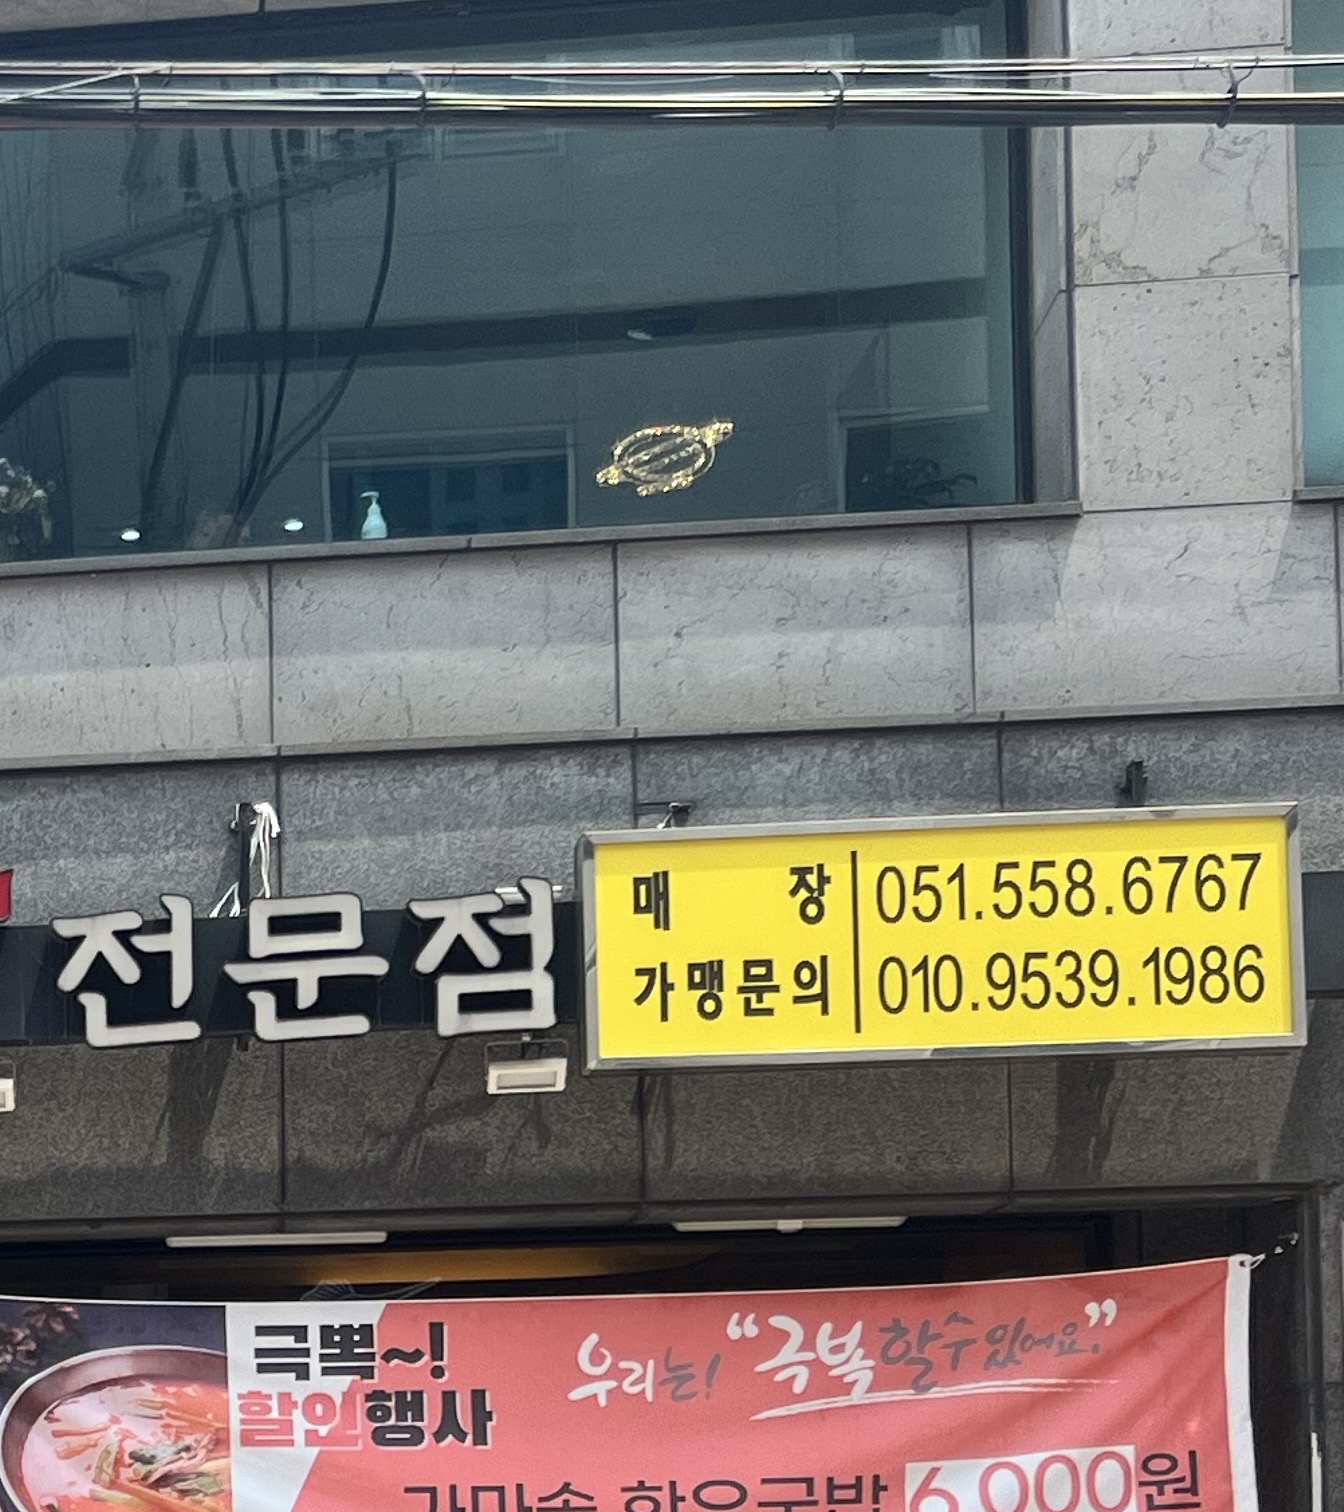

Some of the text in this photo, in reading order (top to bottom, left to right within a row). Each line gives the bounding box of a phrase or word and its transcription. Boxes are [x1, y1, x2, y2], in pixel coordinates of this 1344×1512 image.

[874, 852, 1262, 928] 051.558.6767
[54, 876, 561, 1048] 전문점
[631, 945, 1267, 1023] 가맹문의 010.9539.1986
[237, 1387, 496, 1450] 할인행사
